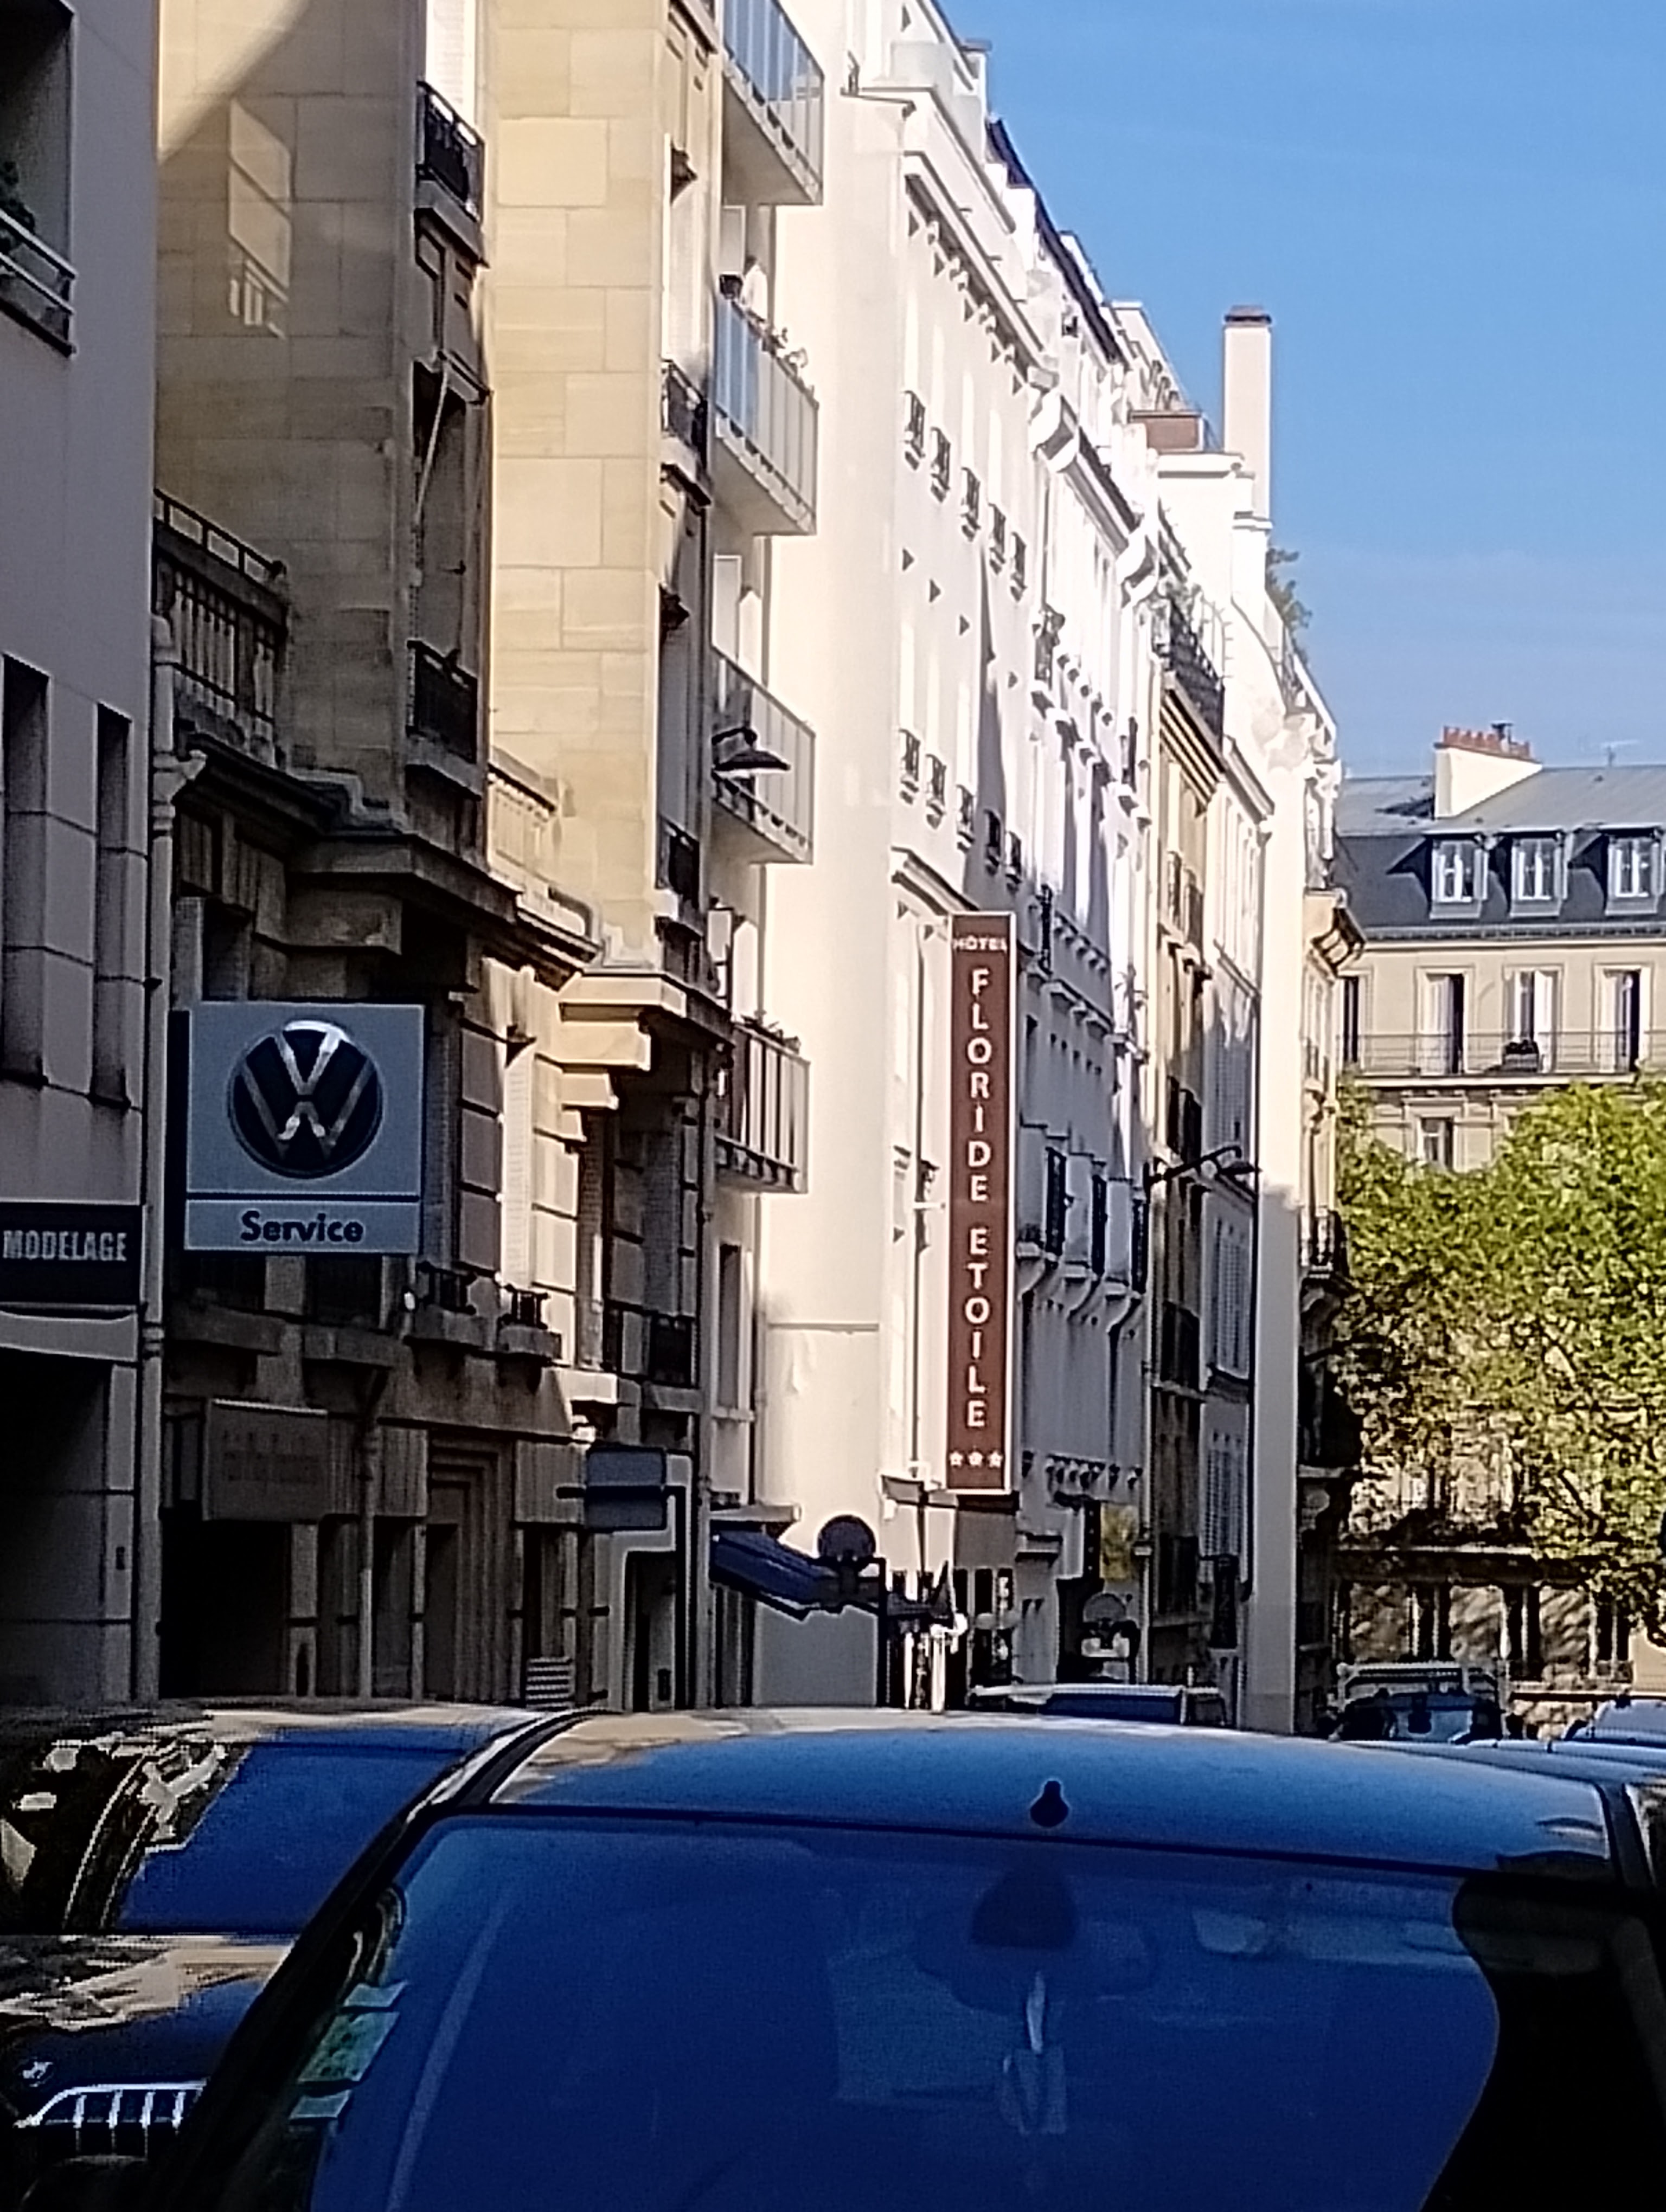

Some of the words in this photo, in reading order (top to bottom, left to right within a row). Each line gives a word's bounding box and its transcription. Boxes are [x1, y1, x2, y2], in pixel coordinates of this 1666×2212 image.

[967, 968, 992, 1202] FLORIDE
[3, 1230, 127, 1262] MODELAGE
[241, 1211, 363, 1242] Service
[965, 1228, 991, 1427] ETOILE
